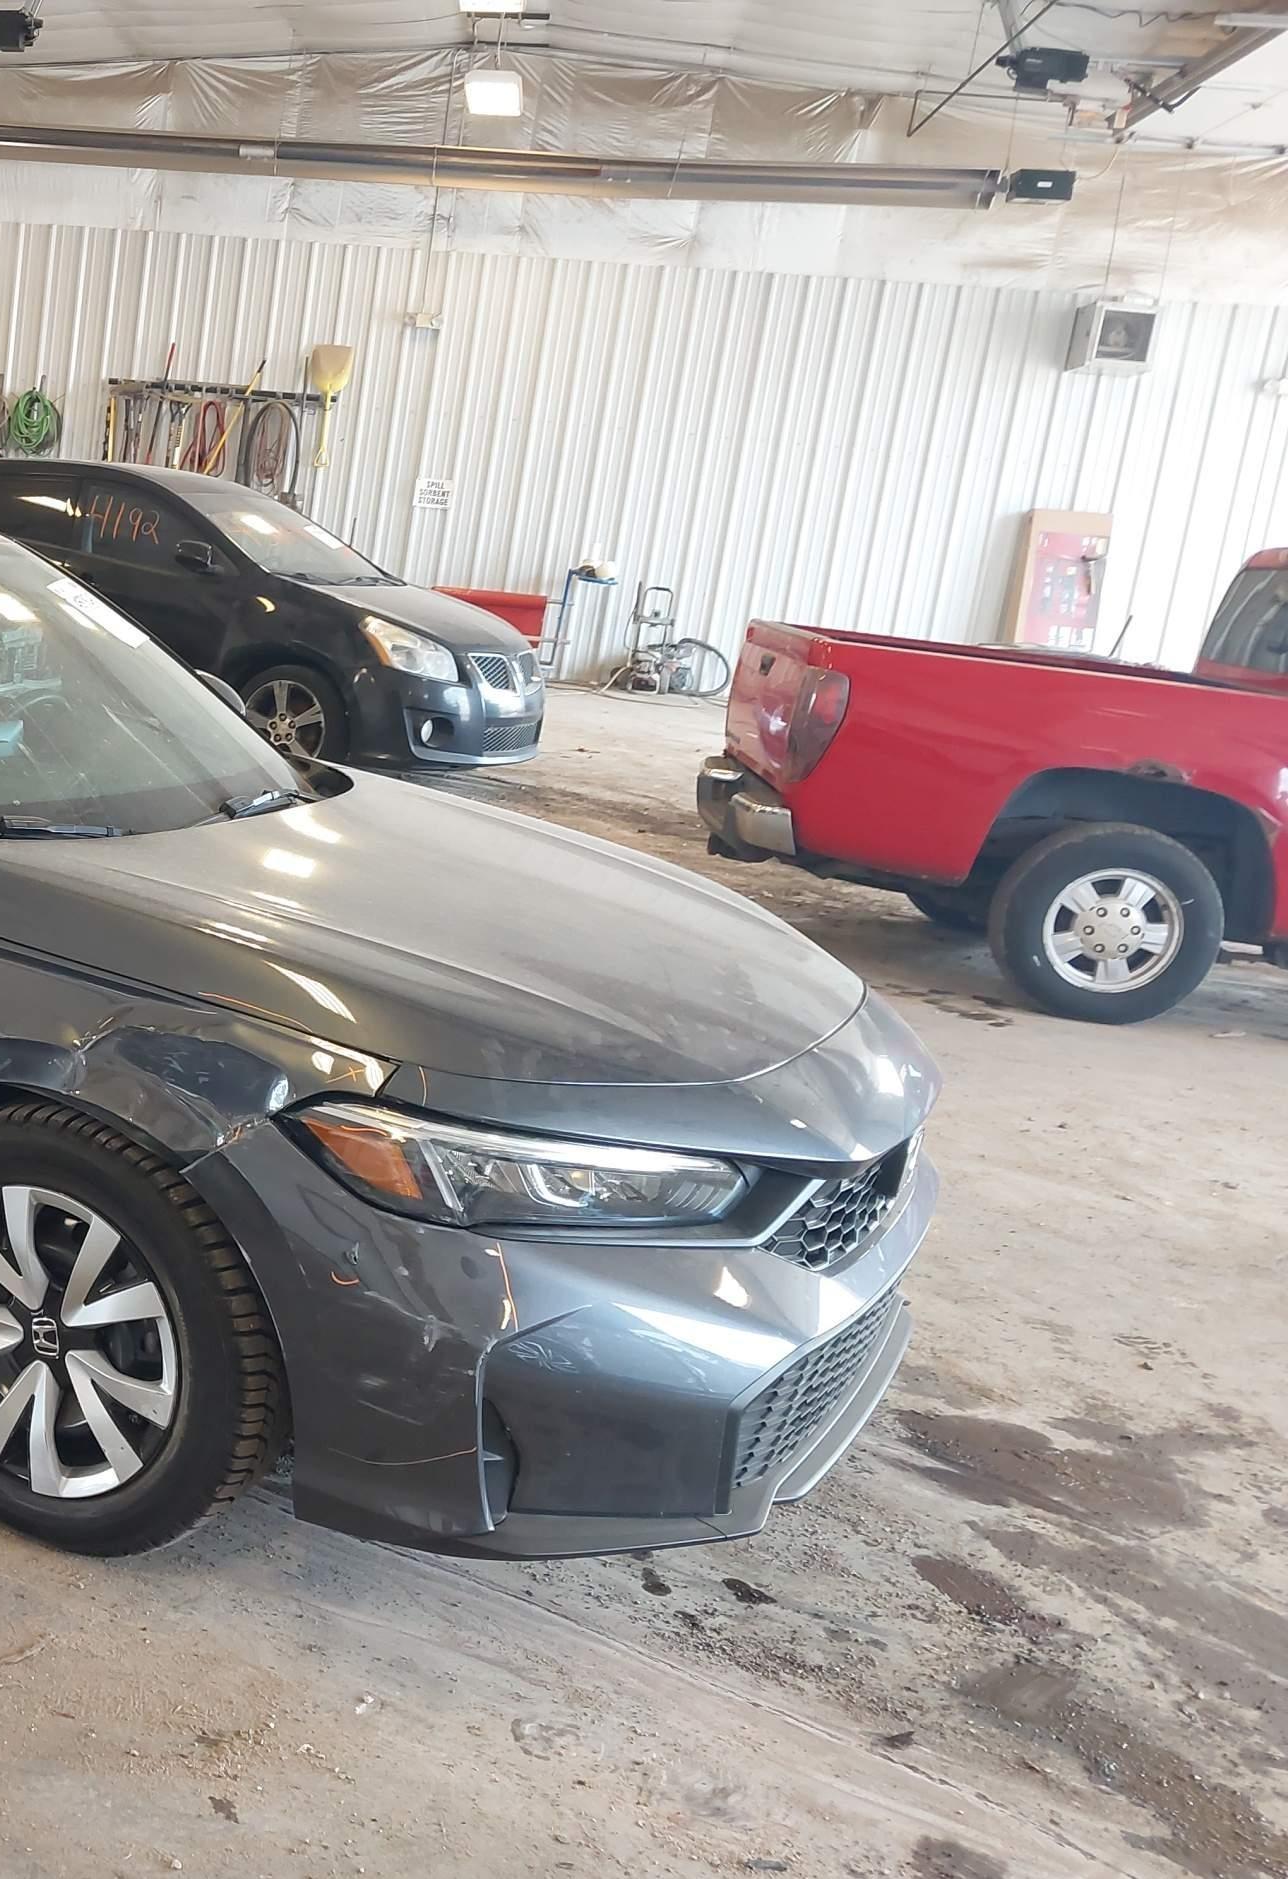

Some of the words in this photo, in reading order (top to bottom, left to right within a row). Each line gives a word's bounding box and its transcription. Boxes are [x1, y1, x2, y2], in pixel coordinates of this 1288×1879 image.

[426, 480, 445, 489] SPILL
[419, 488, 450, 498] SORBENT
[418, 497, 449, 506] STORAGE
[90, 495, 160, 545] 4192
